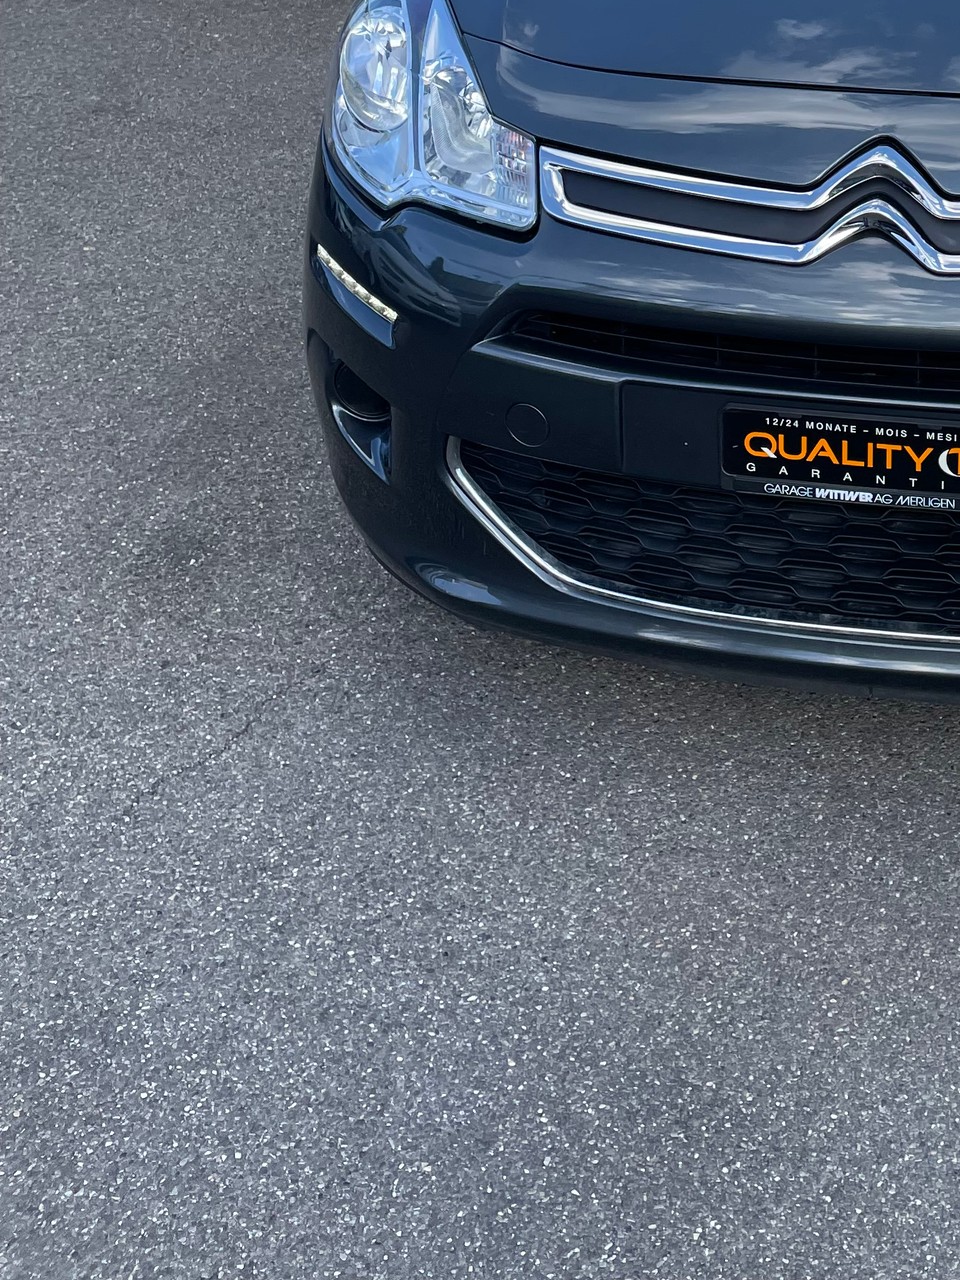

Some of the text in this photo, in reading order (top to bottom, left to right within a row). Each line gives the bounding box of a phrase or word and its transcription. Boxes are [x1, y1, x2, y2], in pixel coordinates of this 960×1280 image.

[765, 417, 799, 428] 12/24
[805, 421, 857, 433] MONATE
[875, 427, 908, 438] MOIS
[926, 431, 958, 442] MESI
[743, 431, 934, 472] QUALITY
[763, 483, 956, 509] GARAGE WITTWER AG MERLIGEN
